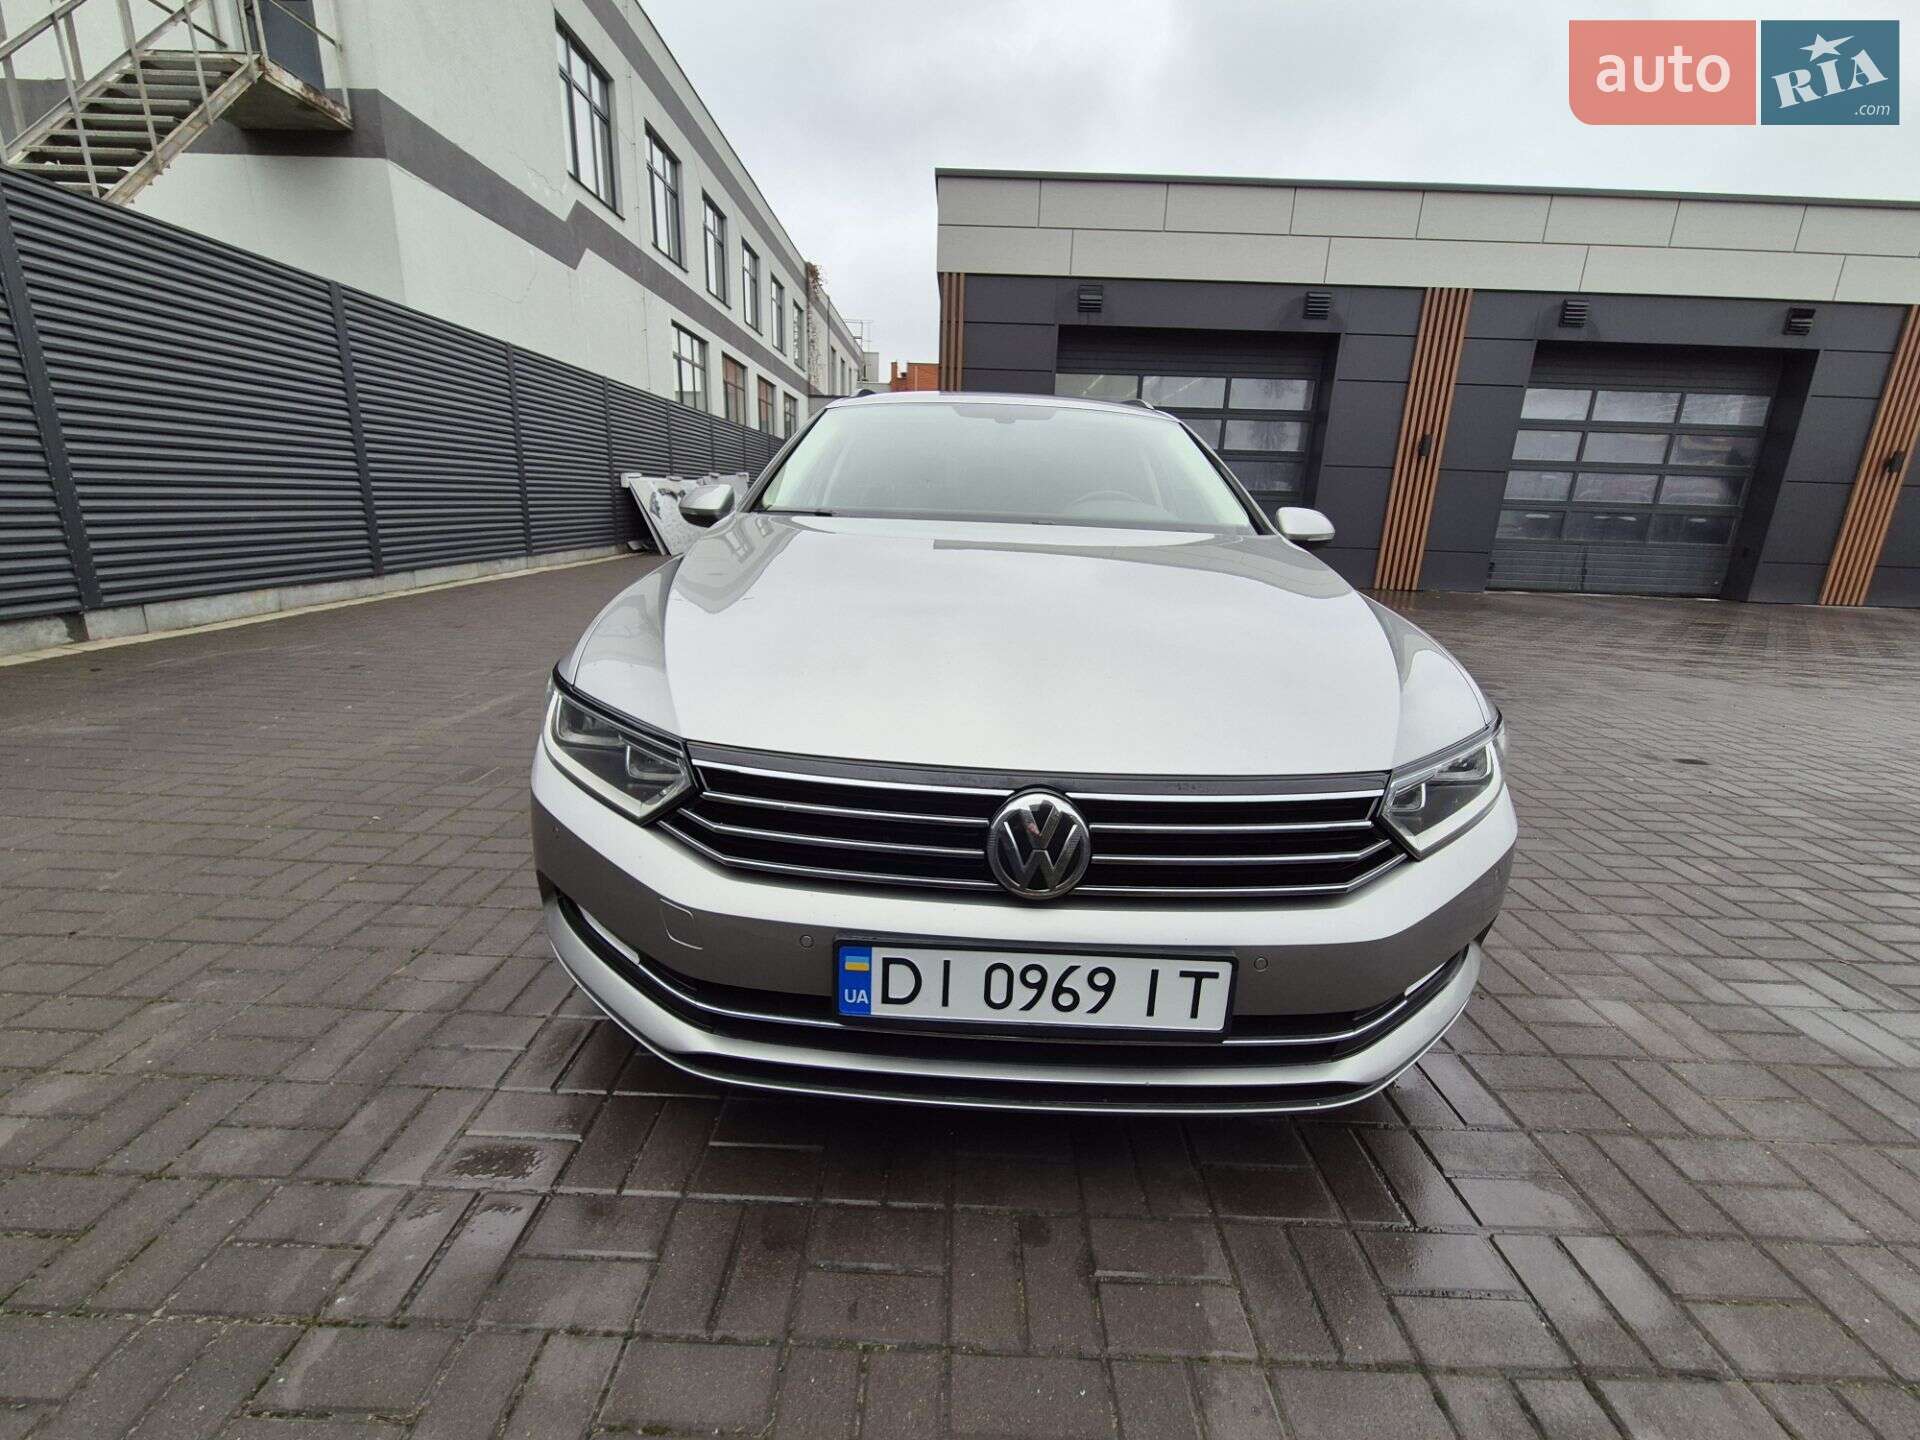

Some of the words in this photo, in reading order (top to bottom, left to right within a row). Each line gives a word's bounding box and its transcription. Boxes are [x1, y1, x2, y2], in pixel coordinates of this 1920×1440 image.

[844, 988, 869, 1005] UA
[881, 956, 951, 1008] DI
[983, 962, 1117, 1014] 0969
[1145, 968, 1220, 1020] IT
